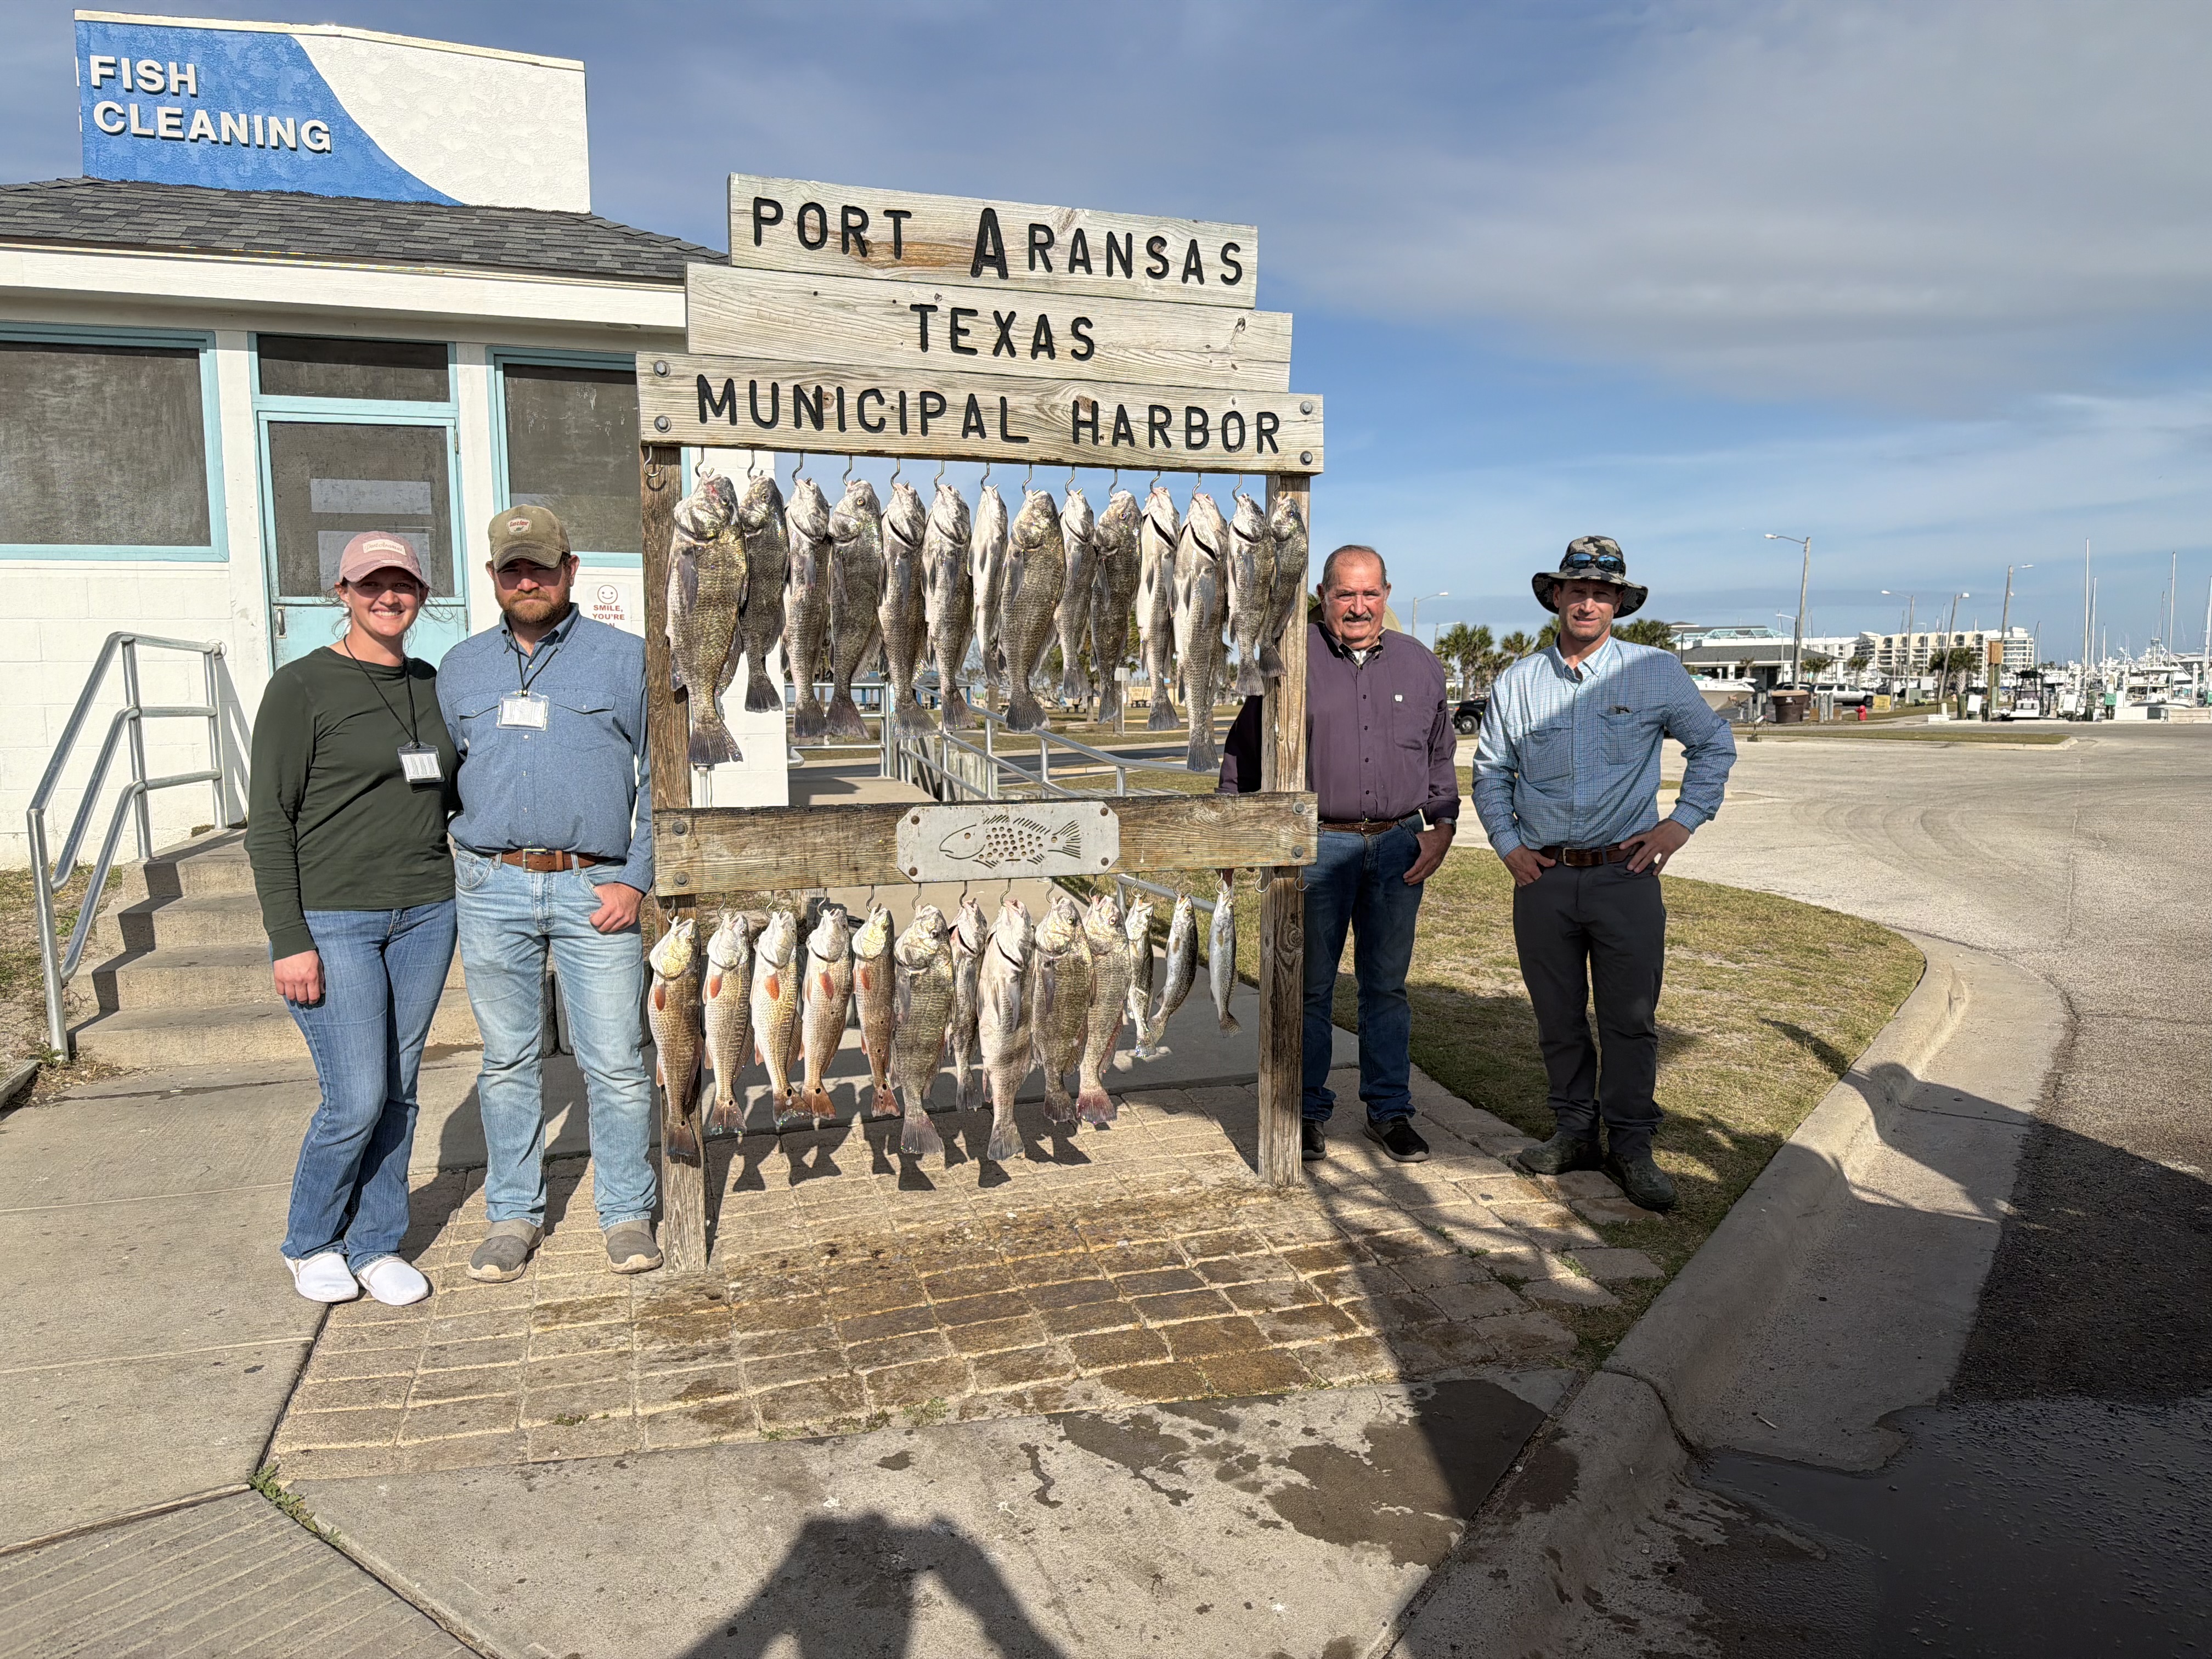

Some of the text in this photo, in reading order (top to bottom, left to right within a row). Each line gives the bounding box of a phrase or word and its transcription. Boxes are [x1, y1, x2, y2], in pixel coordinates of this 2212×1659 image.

[90, 54, 198, 95] FISH
[93, 100, 331, 151] CLEANING
[753, 196, 1243, 285] PORT ARANSAS
[909, 303, 1095, 362] TEXAS
[696, 374, 1279, 454] MUNICIPAL HARBOR
[364, 543, 378, 551] Port
[593, 604, 623, 613] SMILE,
